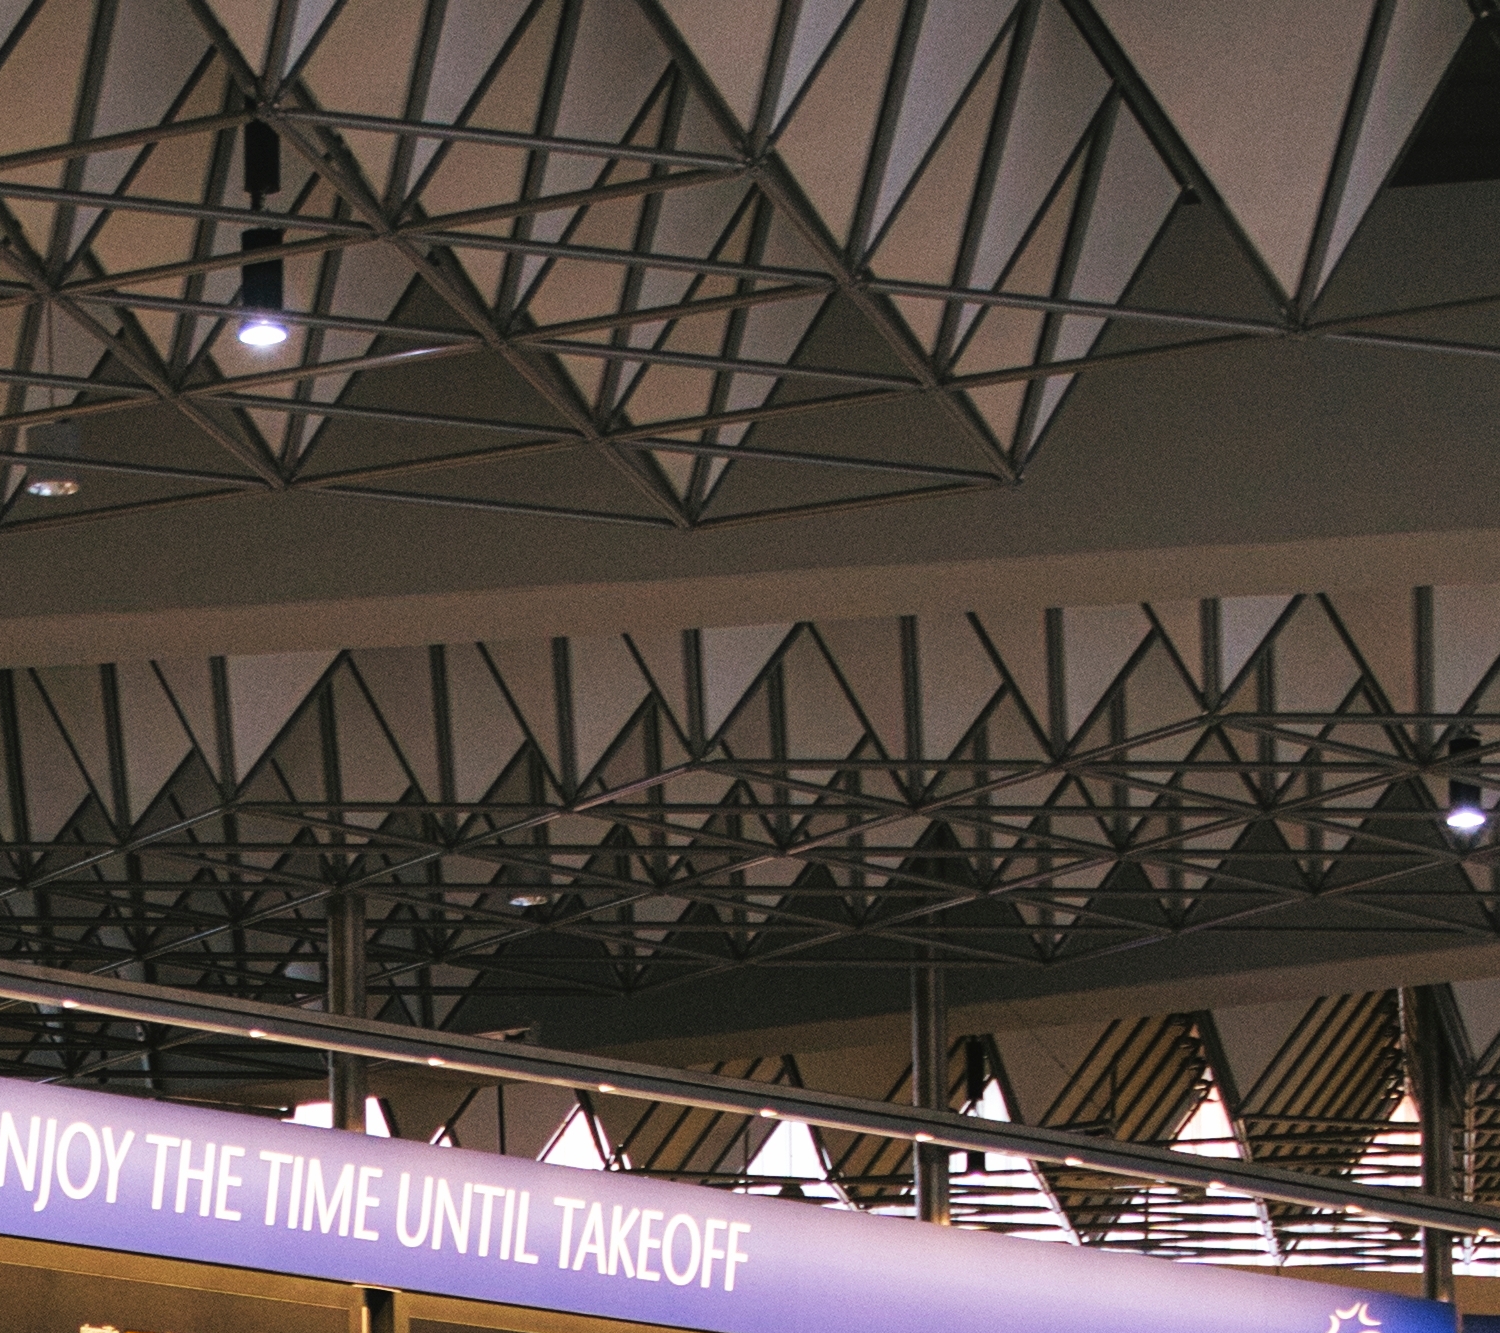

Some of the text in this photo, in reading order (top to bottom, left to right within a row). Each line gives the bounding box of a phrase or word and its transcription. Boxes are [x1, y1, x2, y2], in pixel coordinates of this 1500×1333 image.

[146, 1132, 244, 1223] THE
[259, 1150, 383, 1242] TIME
[395, 1173, 540, 1266] UNTIL
[553, 1196, 752, 1292] TAKEOFF
